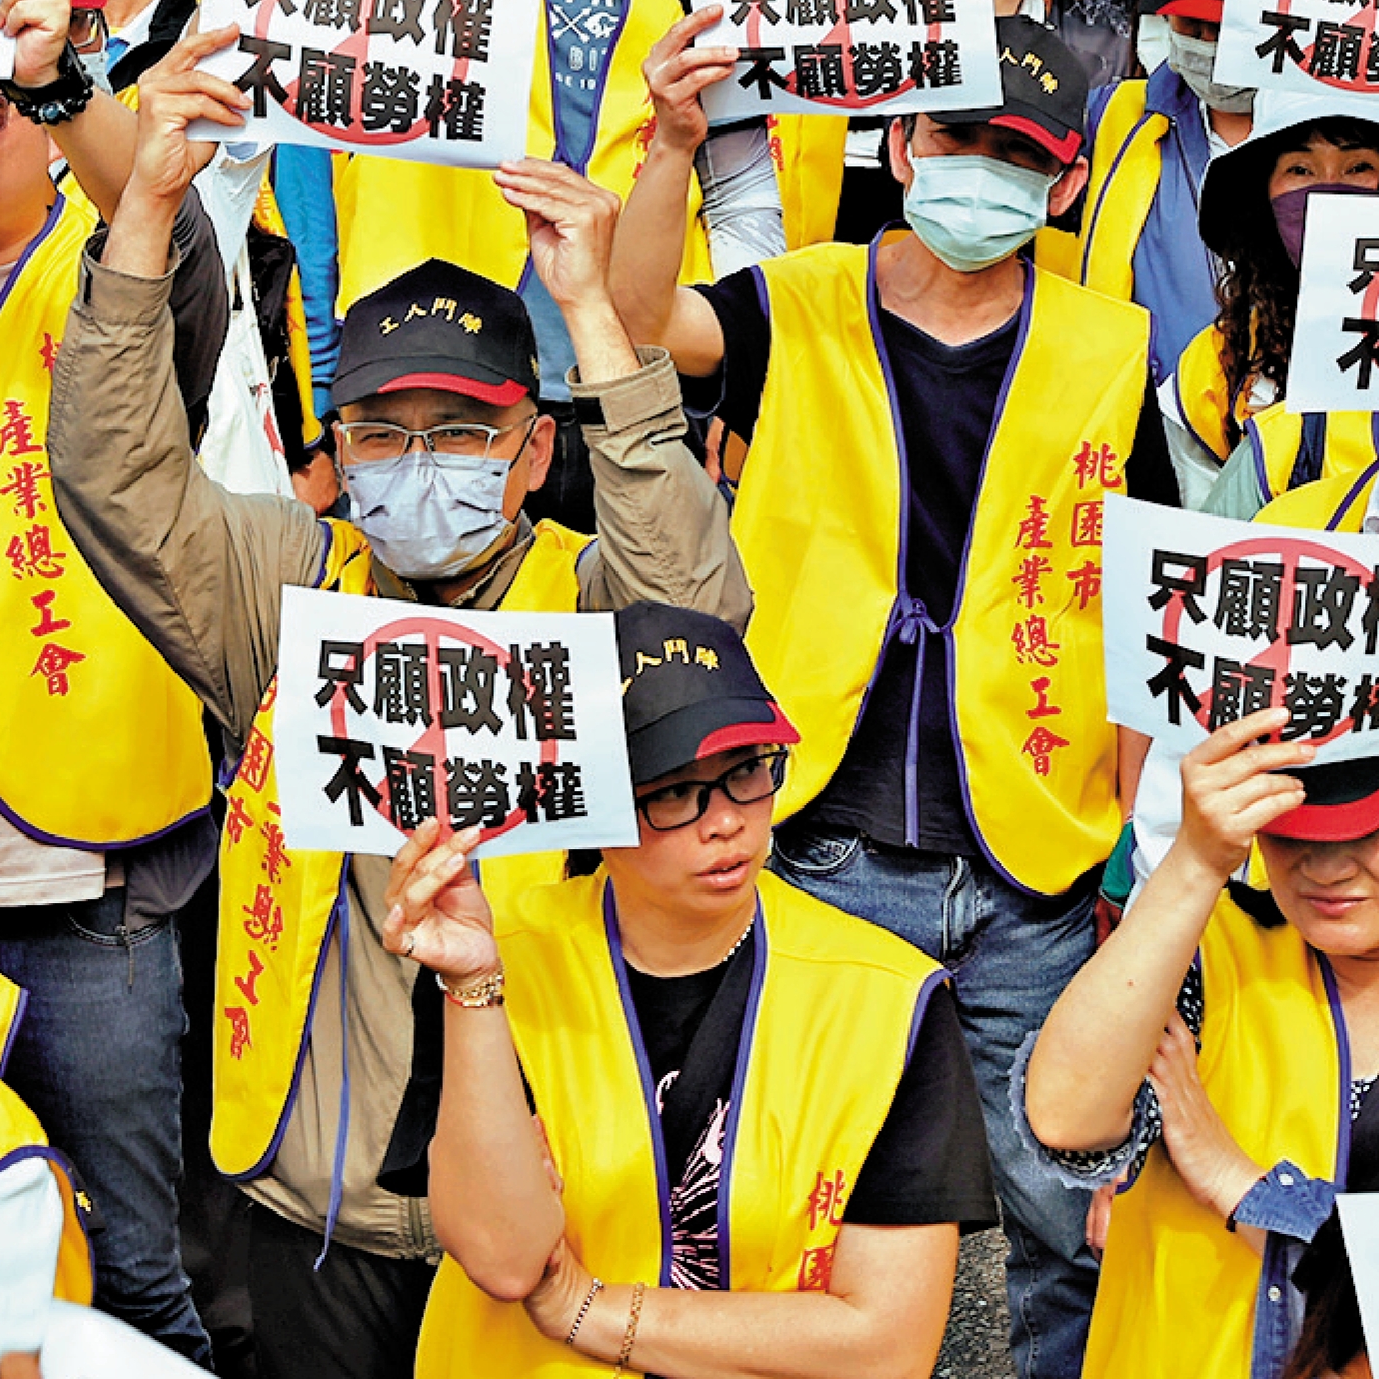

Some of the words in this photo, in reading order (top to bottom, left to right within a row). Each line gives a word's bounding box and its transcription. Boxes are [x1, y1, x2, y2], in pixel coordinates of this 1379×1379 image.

[233, 34, 487, 142] 不顧勞權
[737, 38, 962, 103] 不顧勞權
[1010, 493, 1072, 779] 產業總工會
[314, 639, 578, 742] 只顧政權
[318, 735, 589, 827] 不顧勞權
